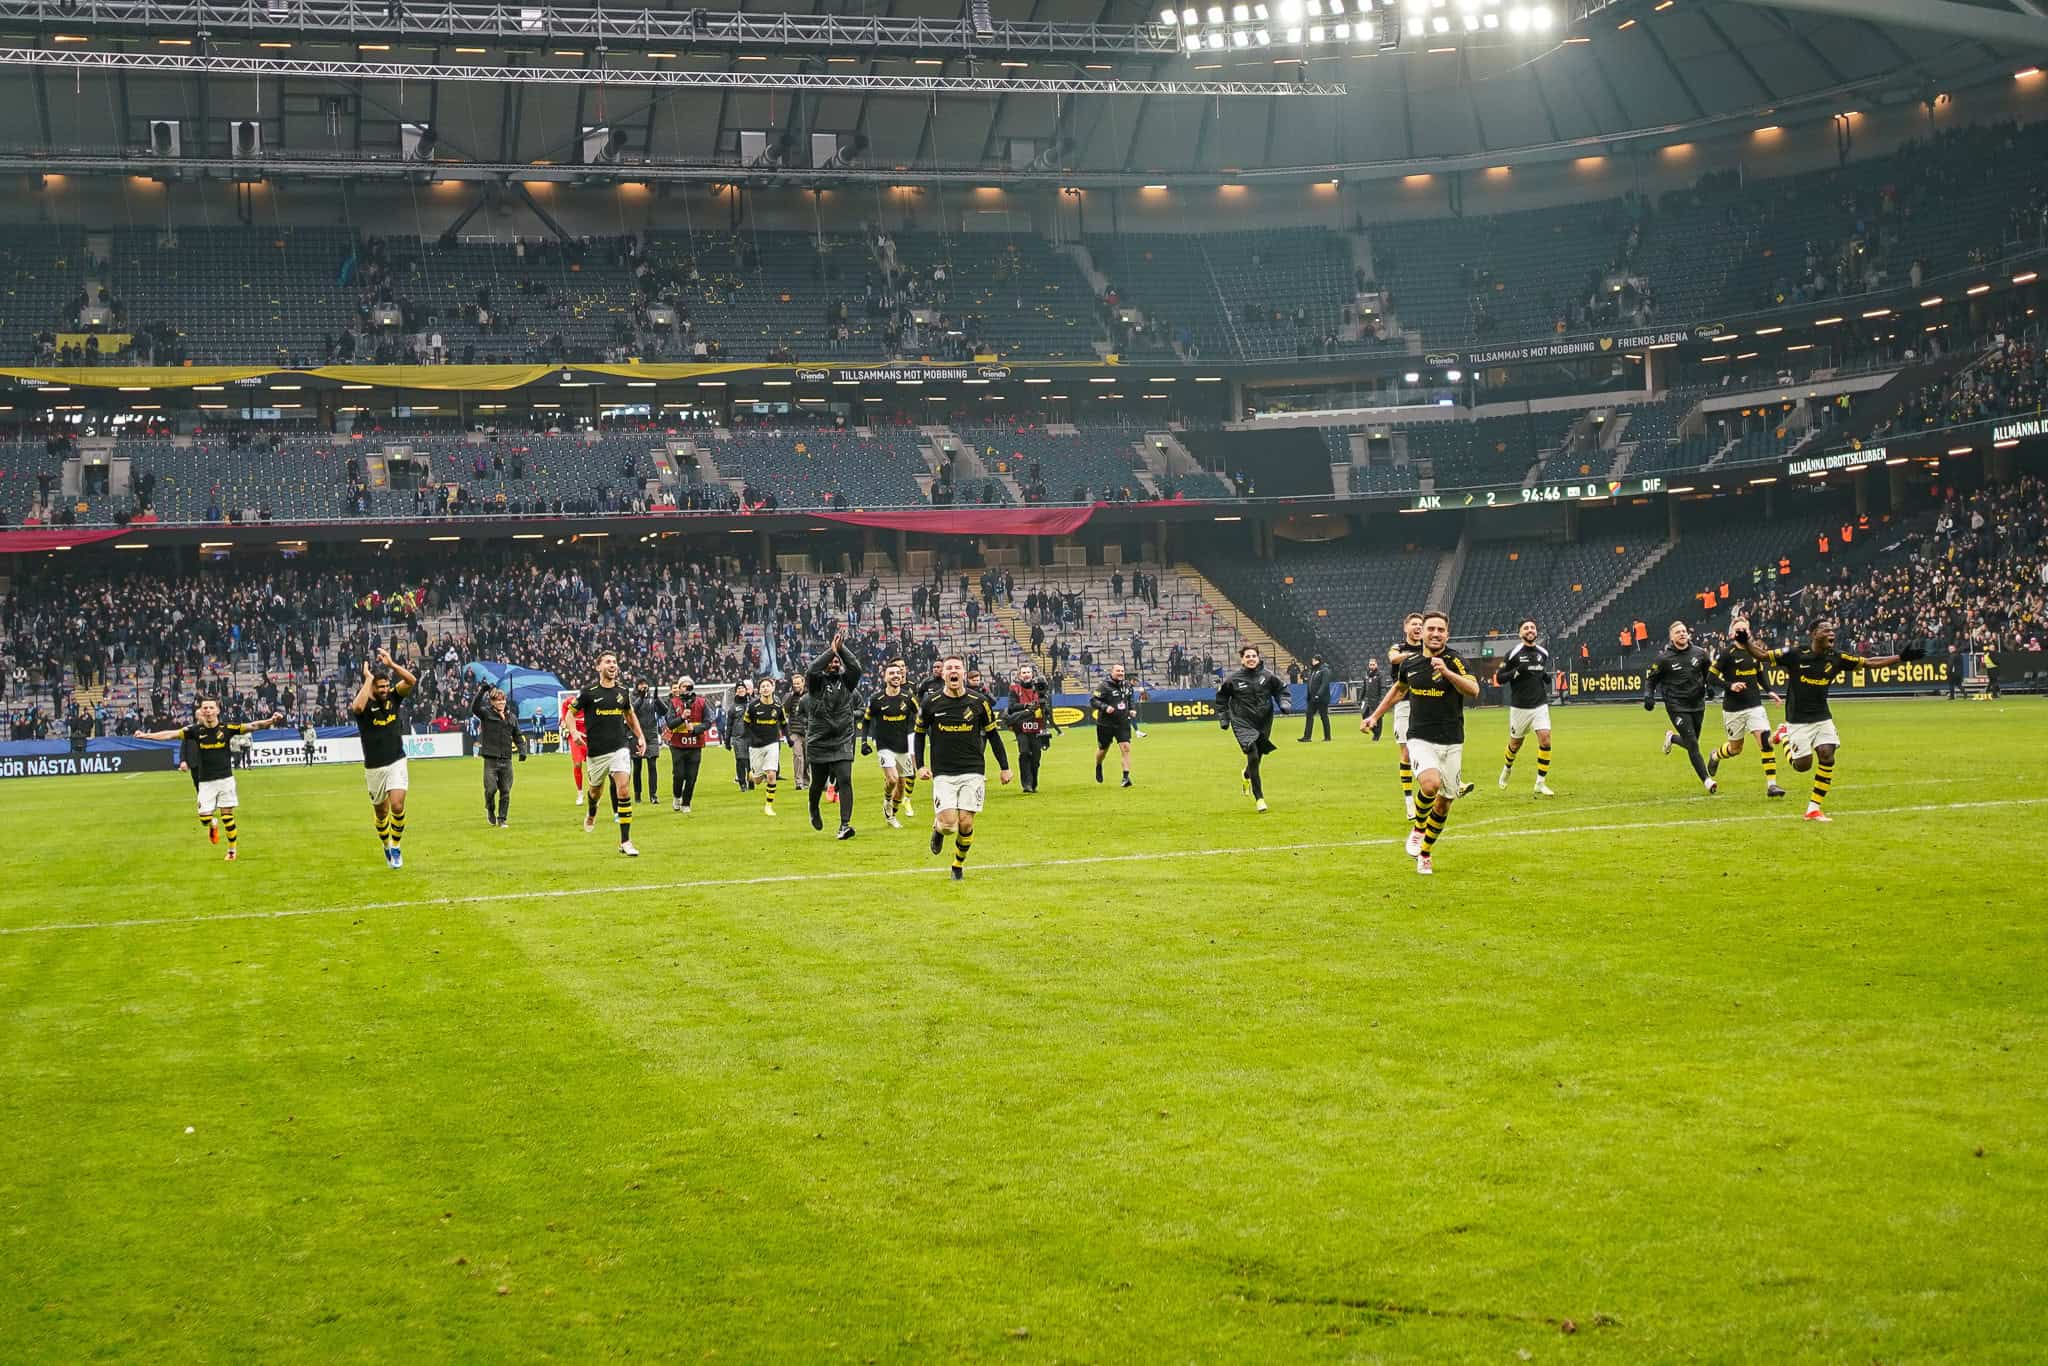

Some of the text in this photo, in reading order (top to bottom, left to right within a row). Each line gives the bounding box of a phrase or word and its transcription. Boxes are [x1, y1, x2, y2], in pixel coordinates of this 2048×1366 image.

[1618, 332, 1688, 348] FRIENDS ARENA
[1530, 347, 1547, 358] MOT
[1550, 342, 1595, 355] MOBBNING
[840, 369, 968, 381] TILLSAMMANS MOT MOBBNING
[1825, 447, 1887, 470] IDROTTSKLUBBEN
[1418, 496, 1441, 509] AIK
[1487, 492, 1496, 505] 2
[1522, 486, 1561, 502] 94:46
[1588, 484, 1597, 496] 0
[1643, 478, 1661, 492] DIF
[1870, 661, 1948, 683] ve-sten.s
[1582, 673, 1642, 692] ve-sten.se
[681, 736, 697, 745] 015
[28, 756, 77, 775] NÄSTA
[80, 753, 122, 773] MÅL?
